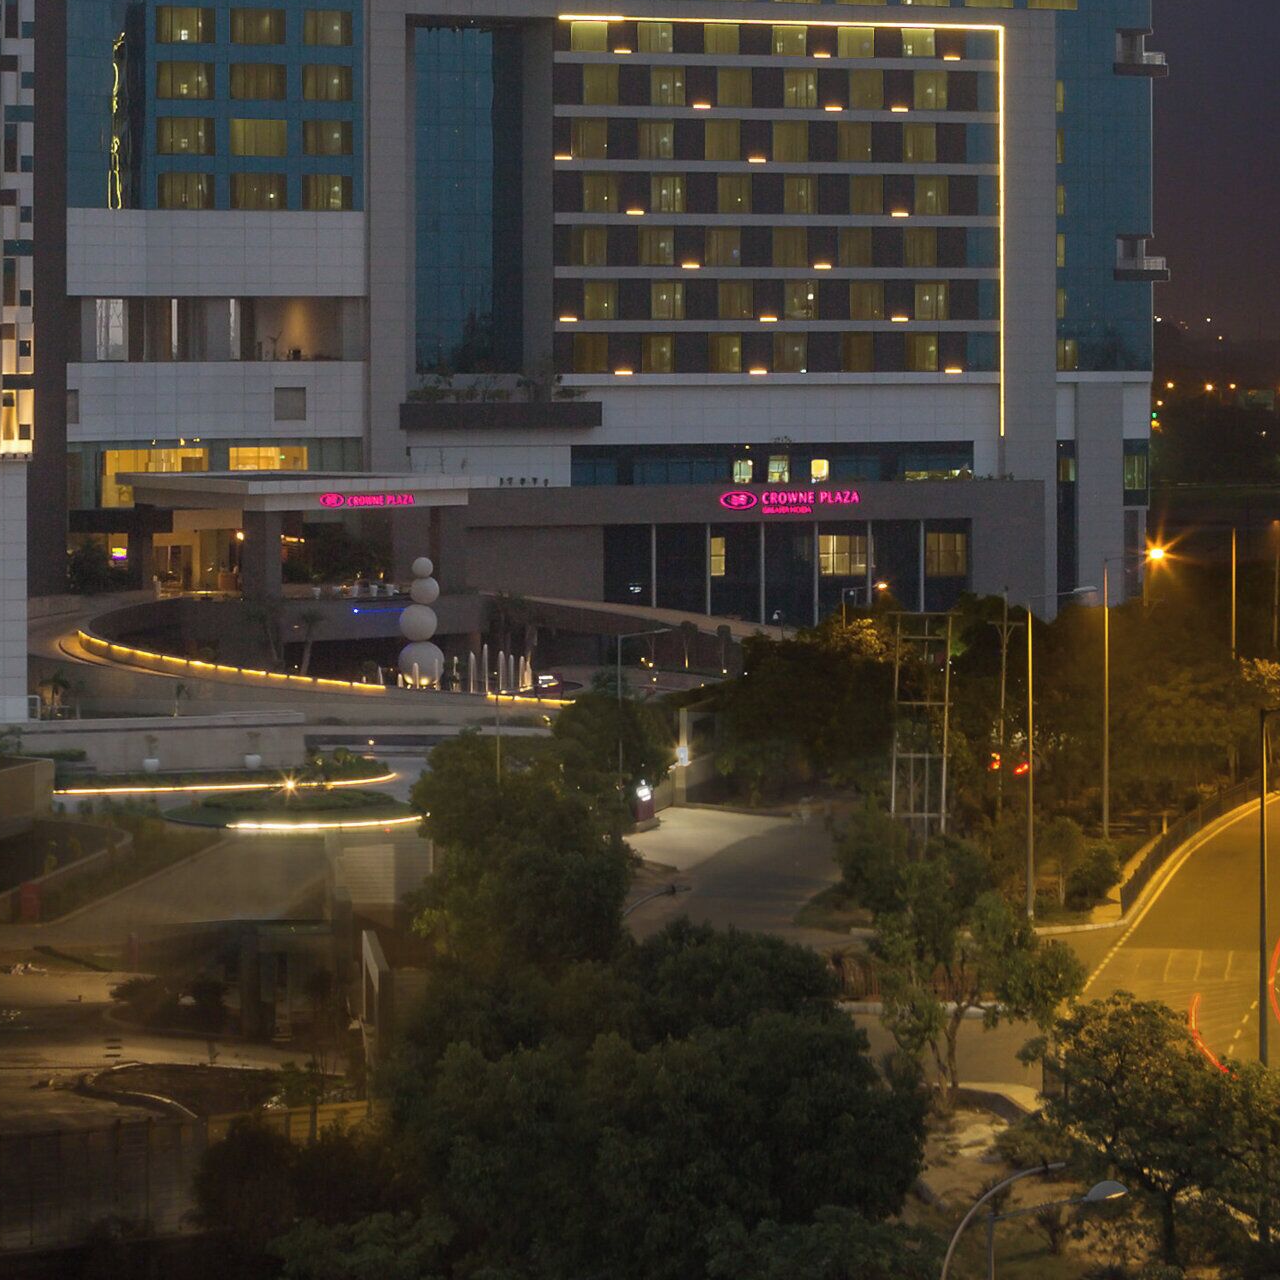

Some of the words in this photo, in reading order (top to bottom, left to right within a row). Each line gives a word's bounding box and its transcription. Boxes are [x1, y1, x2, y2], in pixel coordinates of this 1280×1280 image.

[346, 494, 384, 506] CROWNE
[386, 494, 414, 505] PLAZA
[761, 491, 815, 504] CROWNE
[820, 491, 859, 503] PLAZA
